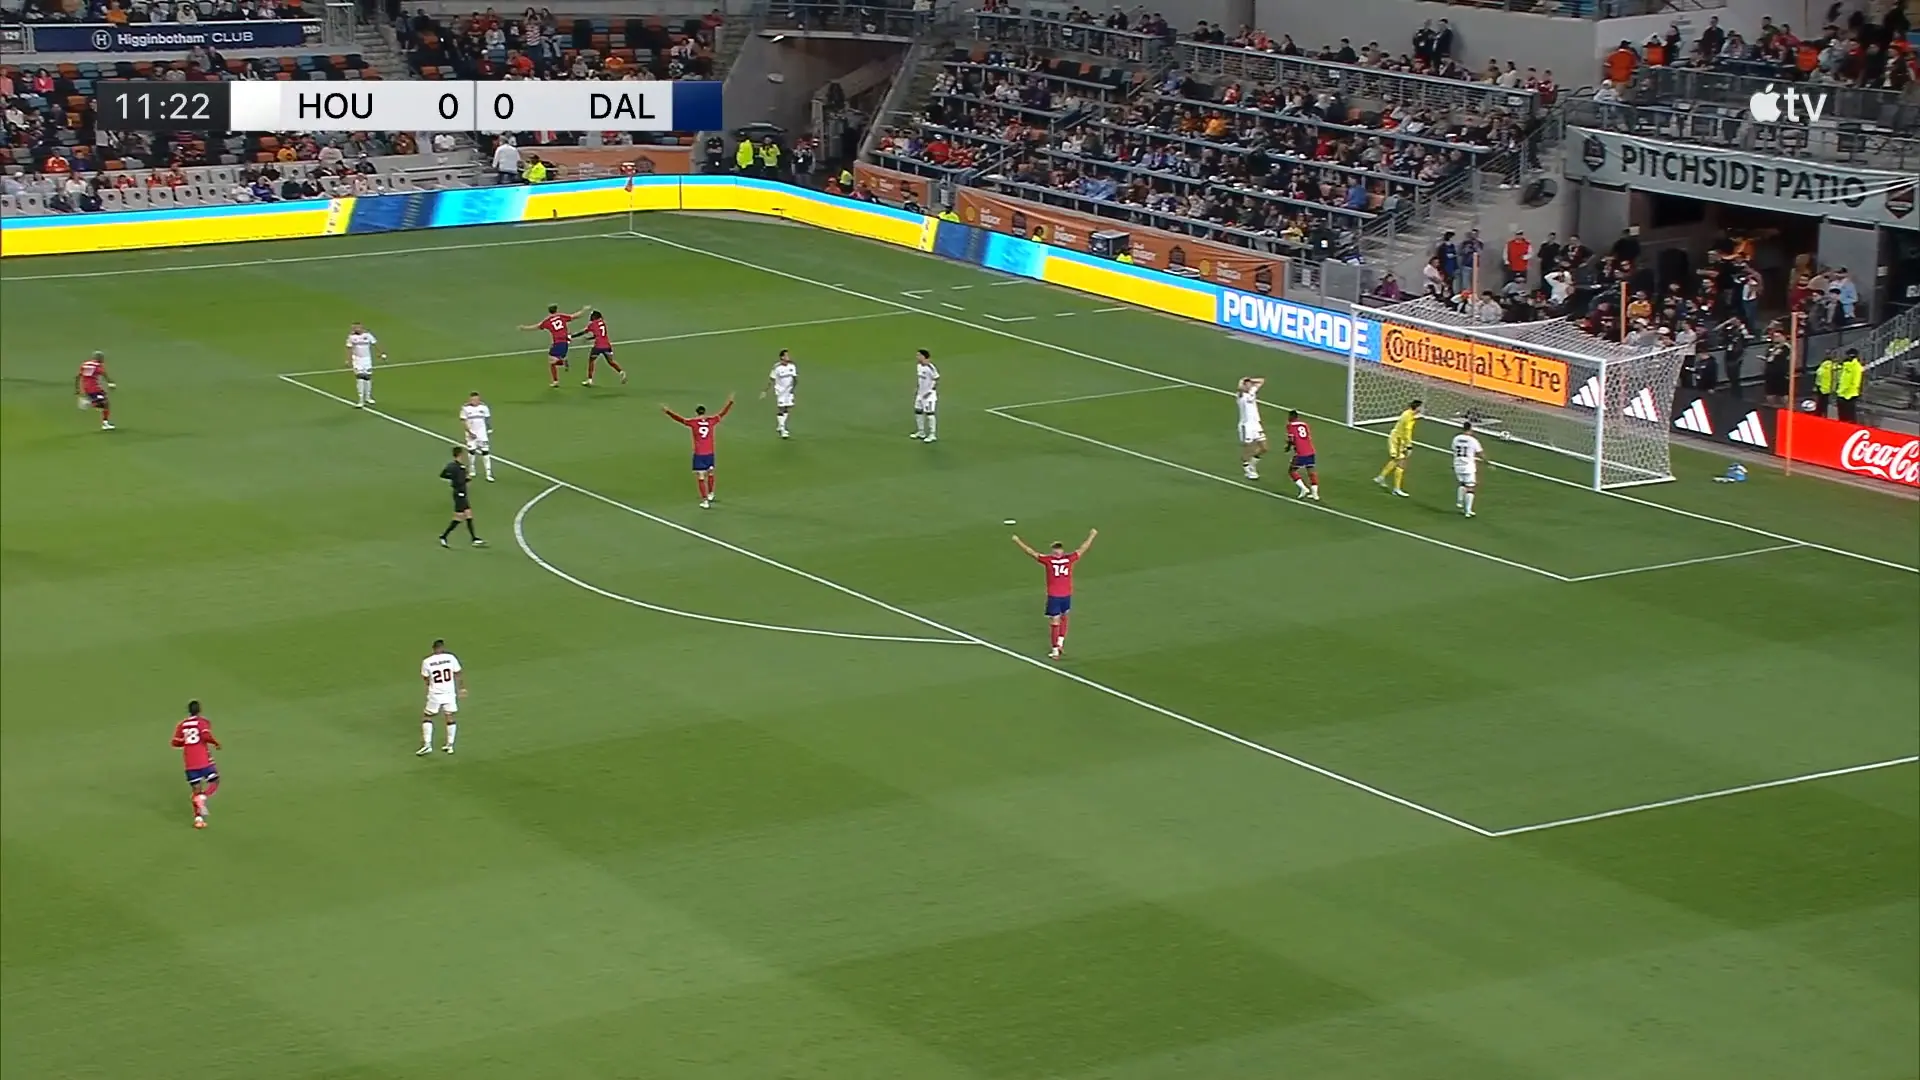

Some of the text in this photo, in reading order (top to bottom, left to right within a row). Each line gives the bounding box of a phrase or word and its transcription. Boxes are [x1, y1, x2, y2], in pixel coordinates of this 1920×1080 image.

[117, 33, 205, 47] Higginbotham
[211, 31, 253, 42] CLUB
[1620, 144, 1867, 208] PITCHSIDE PATIO
[551, 320, 564, 331] 12
[1223, 288, 1371, 356] POWERADE
[1385, 329, 1561, 393] Continental Tire
[698, 426, 710, 438] 9
[1297, 425, 1307, 438] 8
[1052, 564, 1069, 577] 14
[432, 668, 452, 683] 20
